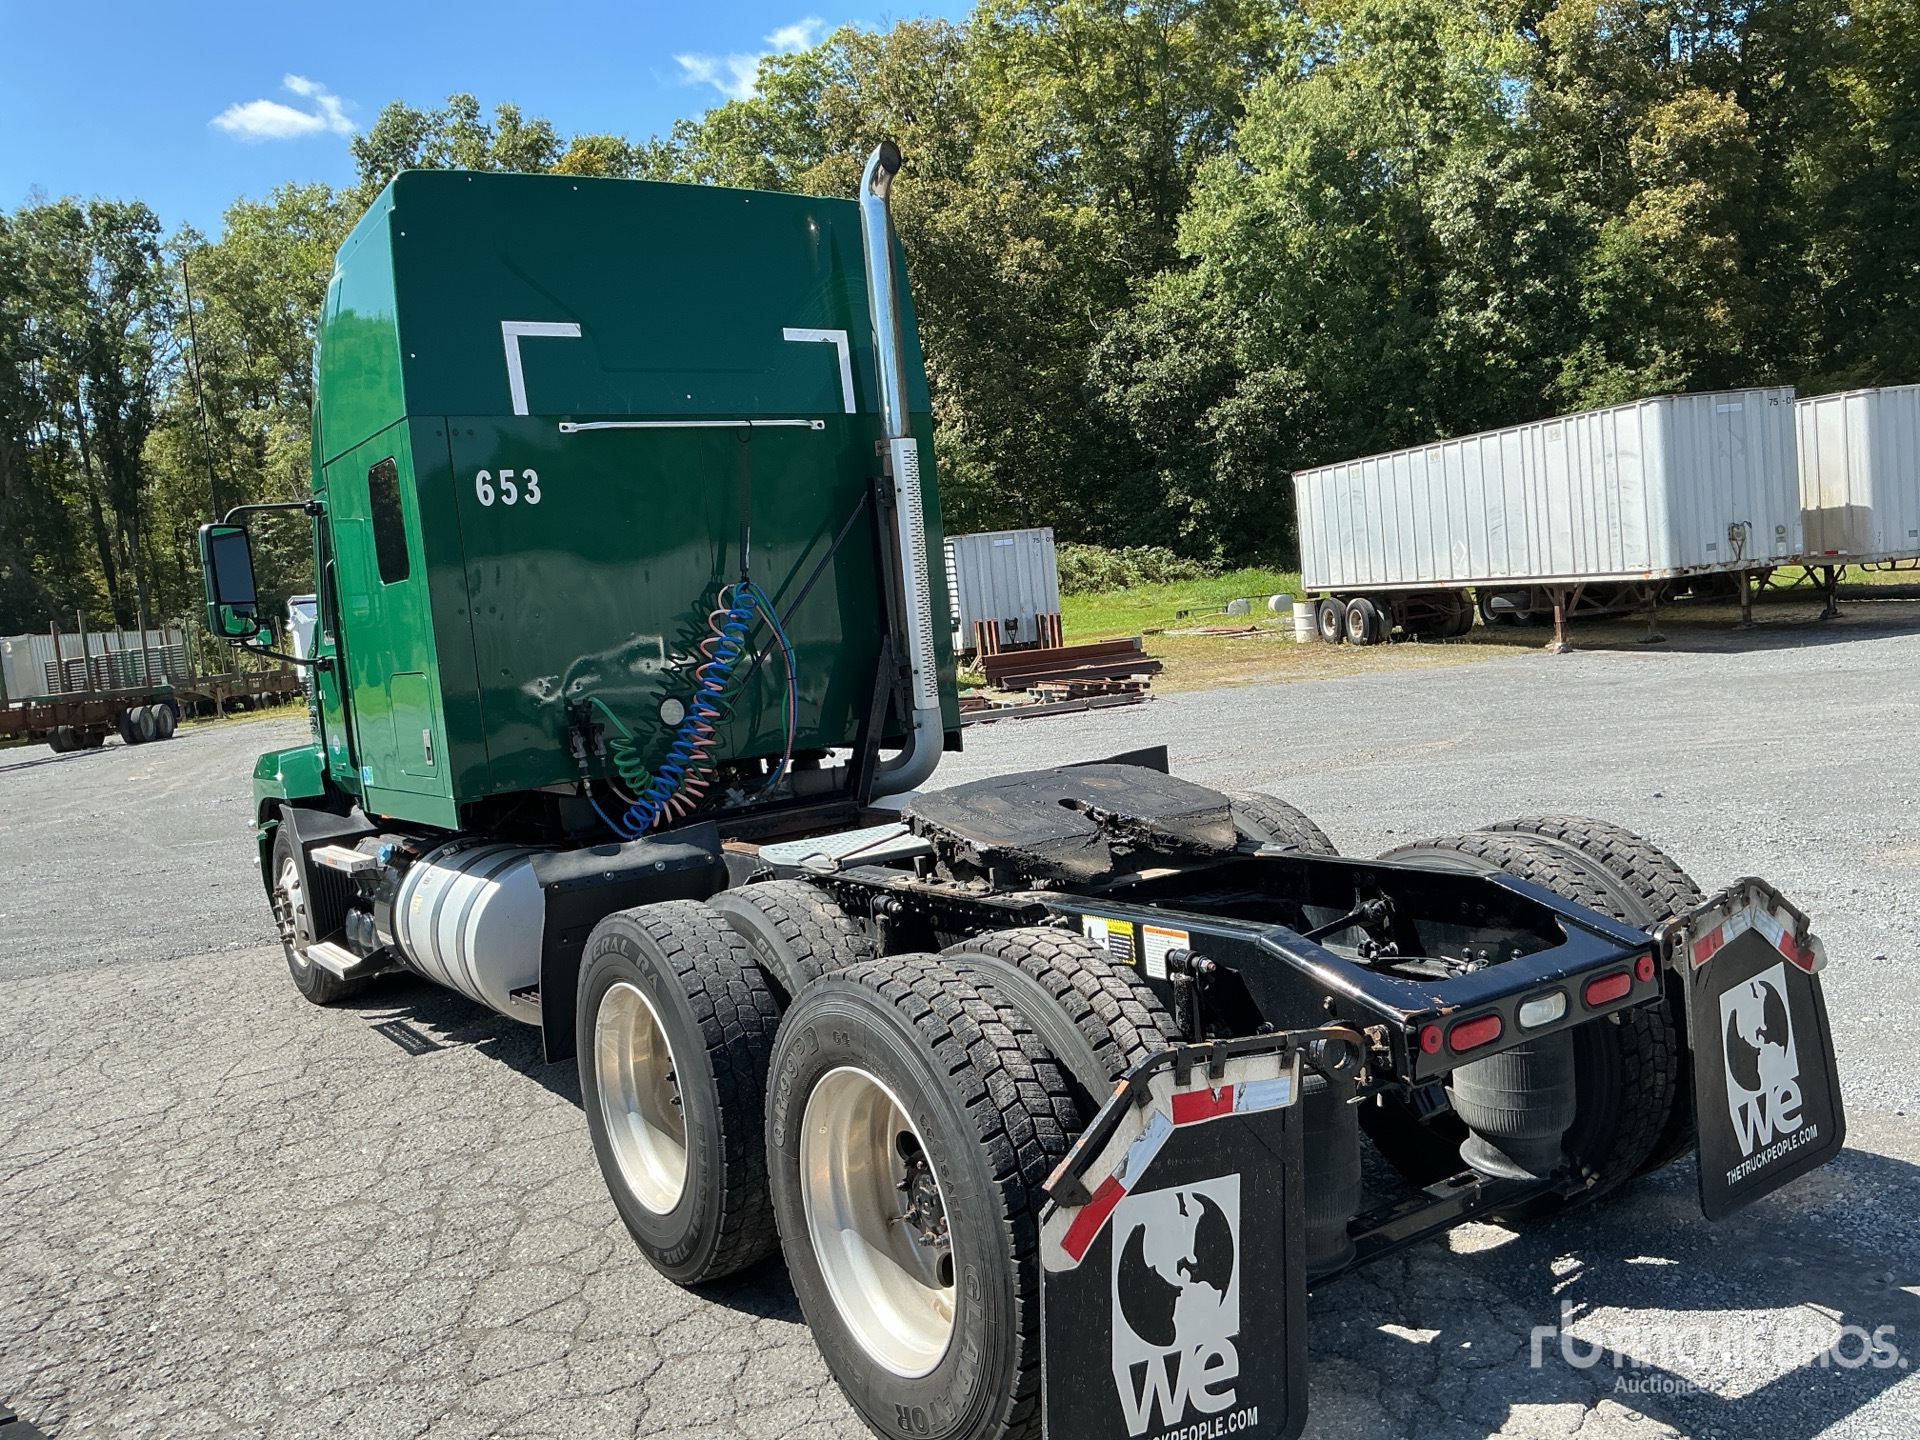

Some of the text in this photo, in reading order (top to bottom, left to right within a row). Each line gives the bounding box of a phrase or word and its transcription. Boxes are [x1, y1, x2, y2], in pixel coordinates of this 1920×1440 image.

[476, 468, 541, 507] 653
[1726, 1124, 1818, 1186] THETRUCKPEOPLE.COM
[894, 1263, 984, 1436] GLADIATOR
